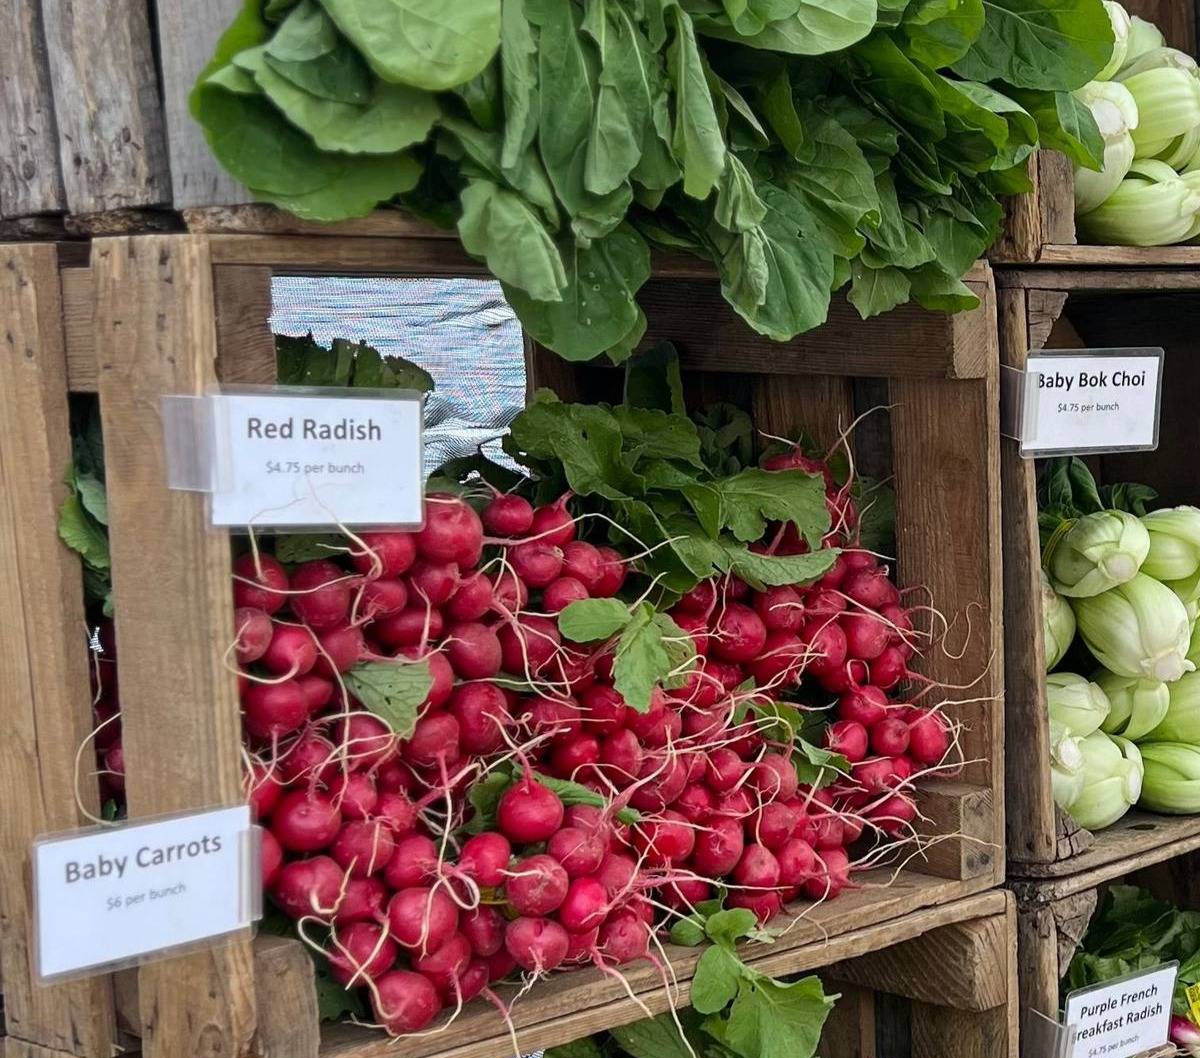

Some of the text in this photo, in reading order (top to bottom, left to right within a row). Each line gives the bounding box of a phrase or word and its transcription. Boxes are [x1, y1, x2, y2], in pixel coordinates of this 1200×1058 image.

[1079, 371, 1108, 388] Bok
[1112, 370, 1146, 387] Choi
[1058, 402, 1120, 414] $4.75 per bunch
[248, 417, 382, 441] Red Radish
[266, 461, 365, 476] $4.75 per bunch
[65, 835, 222, 884] Baby Carrots
[106, 881, 187, 911] $6 per bunch
[1080, 984, 1159, 1020] Purple French
[1126, 1002, 1163, 1025] Radish
[1088, 1034, 1140, 1058] $4.75 per bunch
